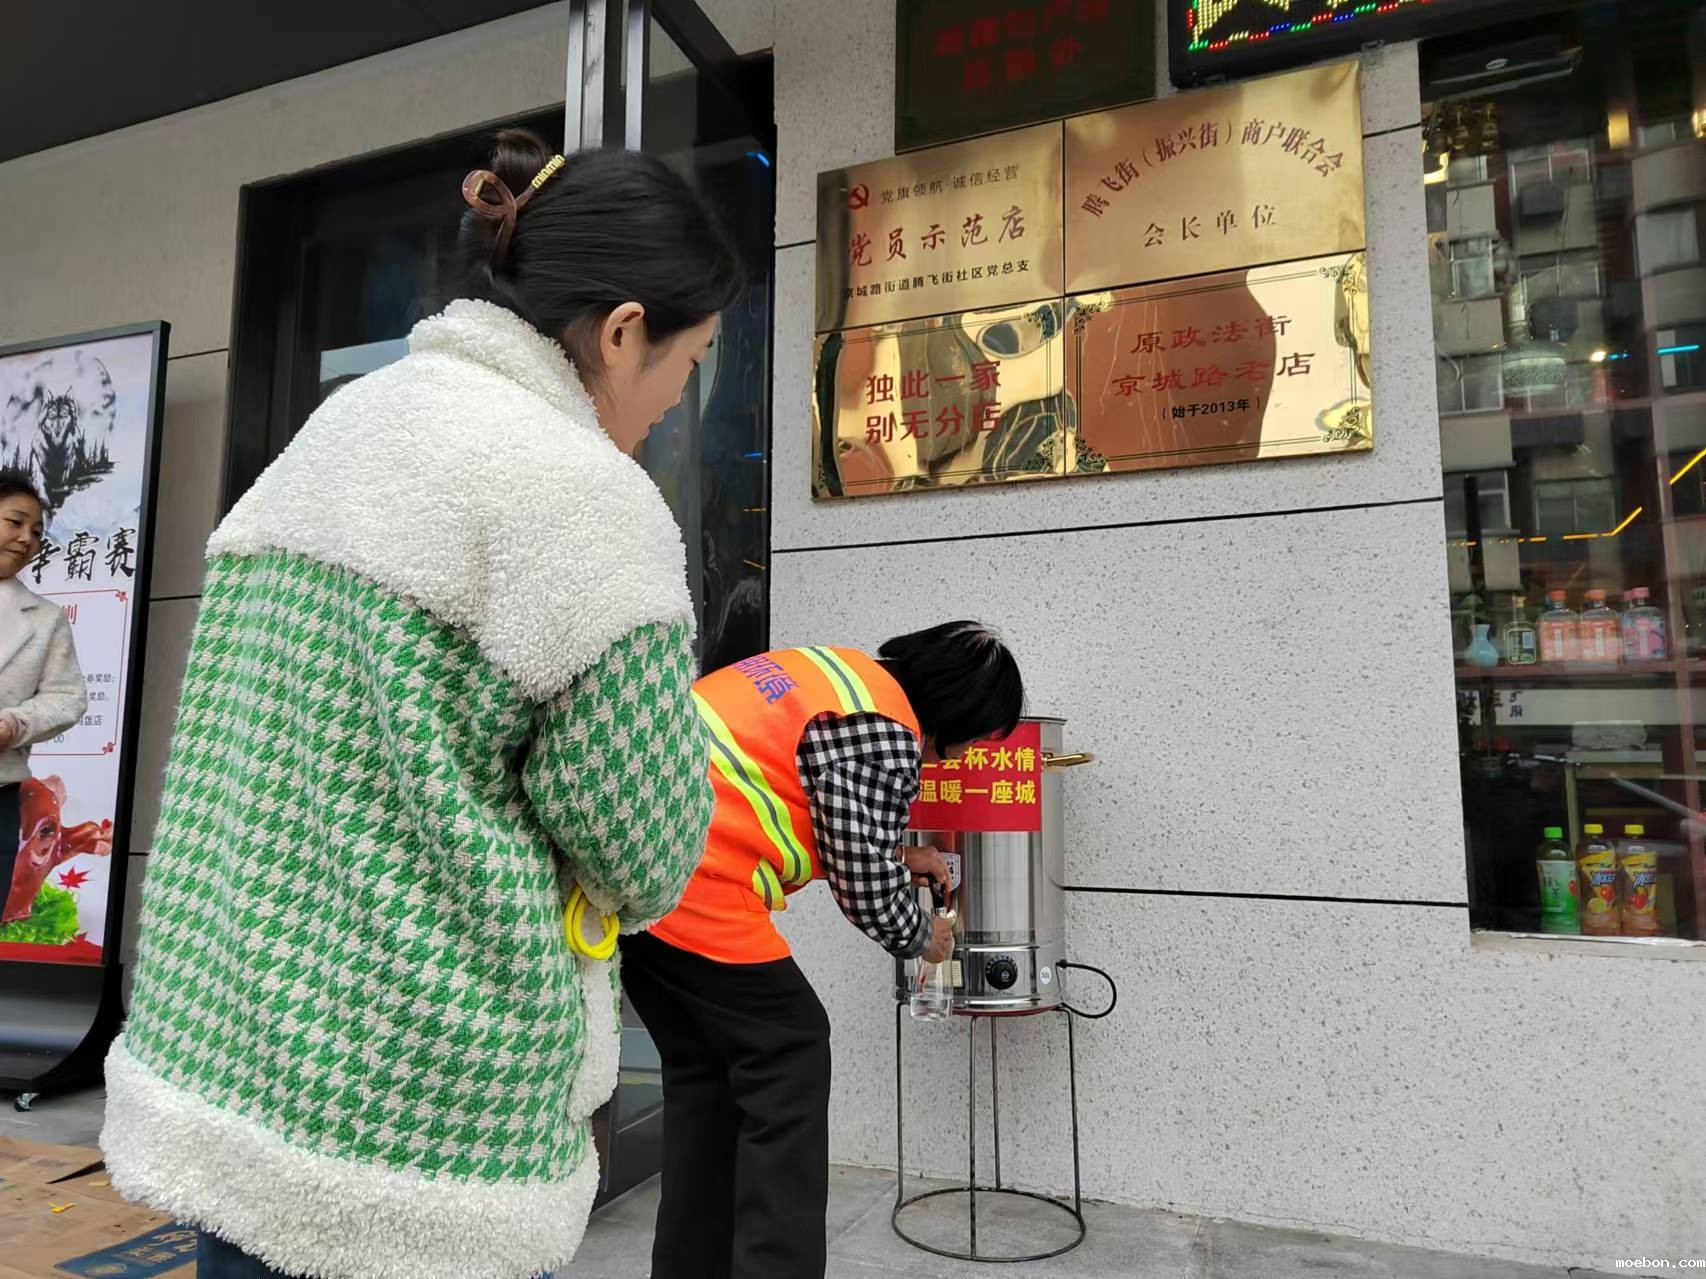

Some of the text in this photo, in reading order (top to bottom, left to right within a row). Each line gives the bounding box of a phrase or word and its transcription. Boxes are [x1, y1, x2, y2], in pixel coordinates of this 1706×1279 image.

[849, 204, 1025, 267] 党员示范店
[1143, 204, 1277, 248] 会长单位
[1130, 315, 1292, 355] 原政法街
[866, 359, 1001, 405] 独此一家
[1111, 351, 1316, 397] 京城路老店
[865, 400, 1001, 445] 别无分店
[919, 779, 1037, 805] 温暖一座城
